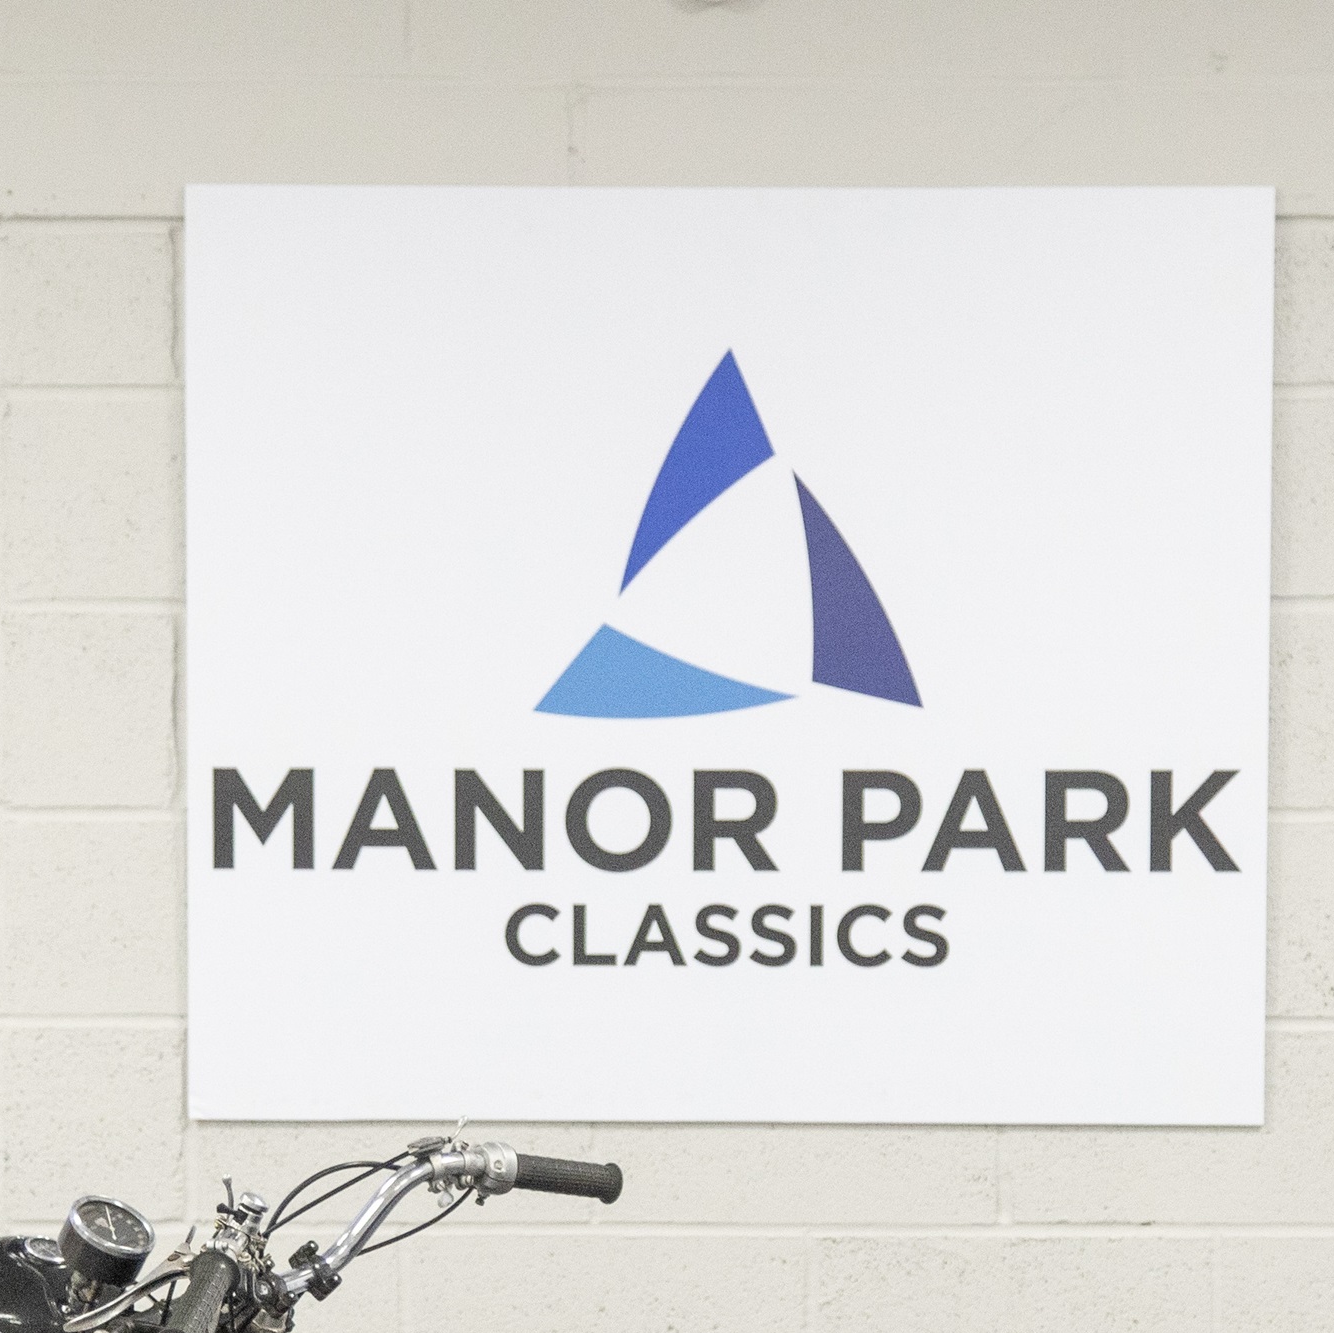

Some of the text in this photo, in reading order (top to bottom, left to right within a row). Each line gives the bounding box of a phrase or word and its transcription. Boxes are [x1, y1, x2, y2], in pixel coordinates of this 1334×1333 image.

[212, 767, 1241, 873] MANOR PARK
[504, 903, 950, 968] CLASSICS
